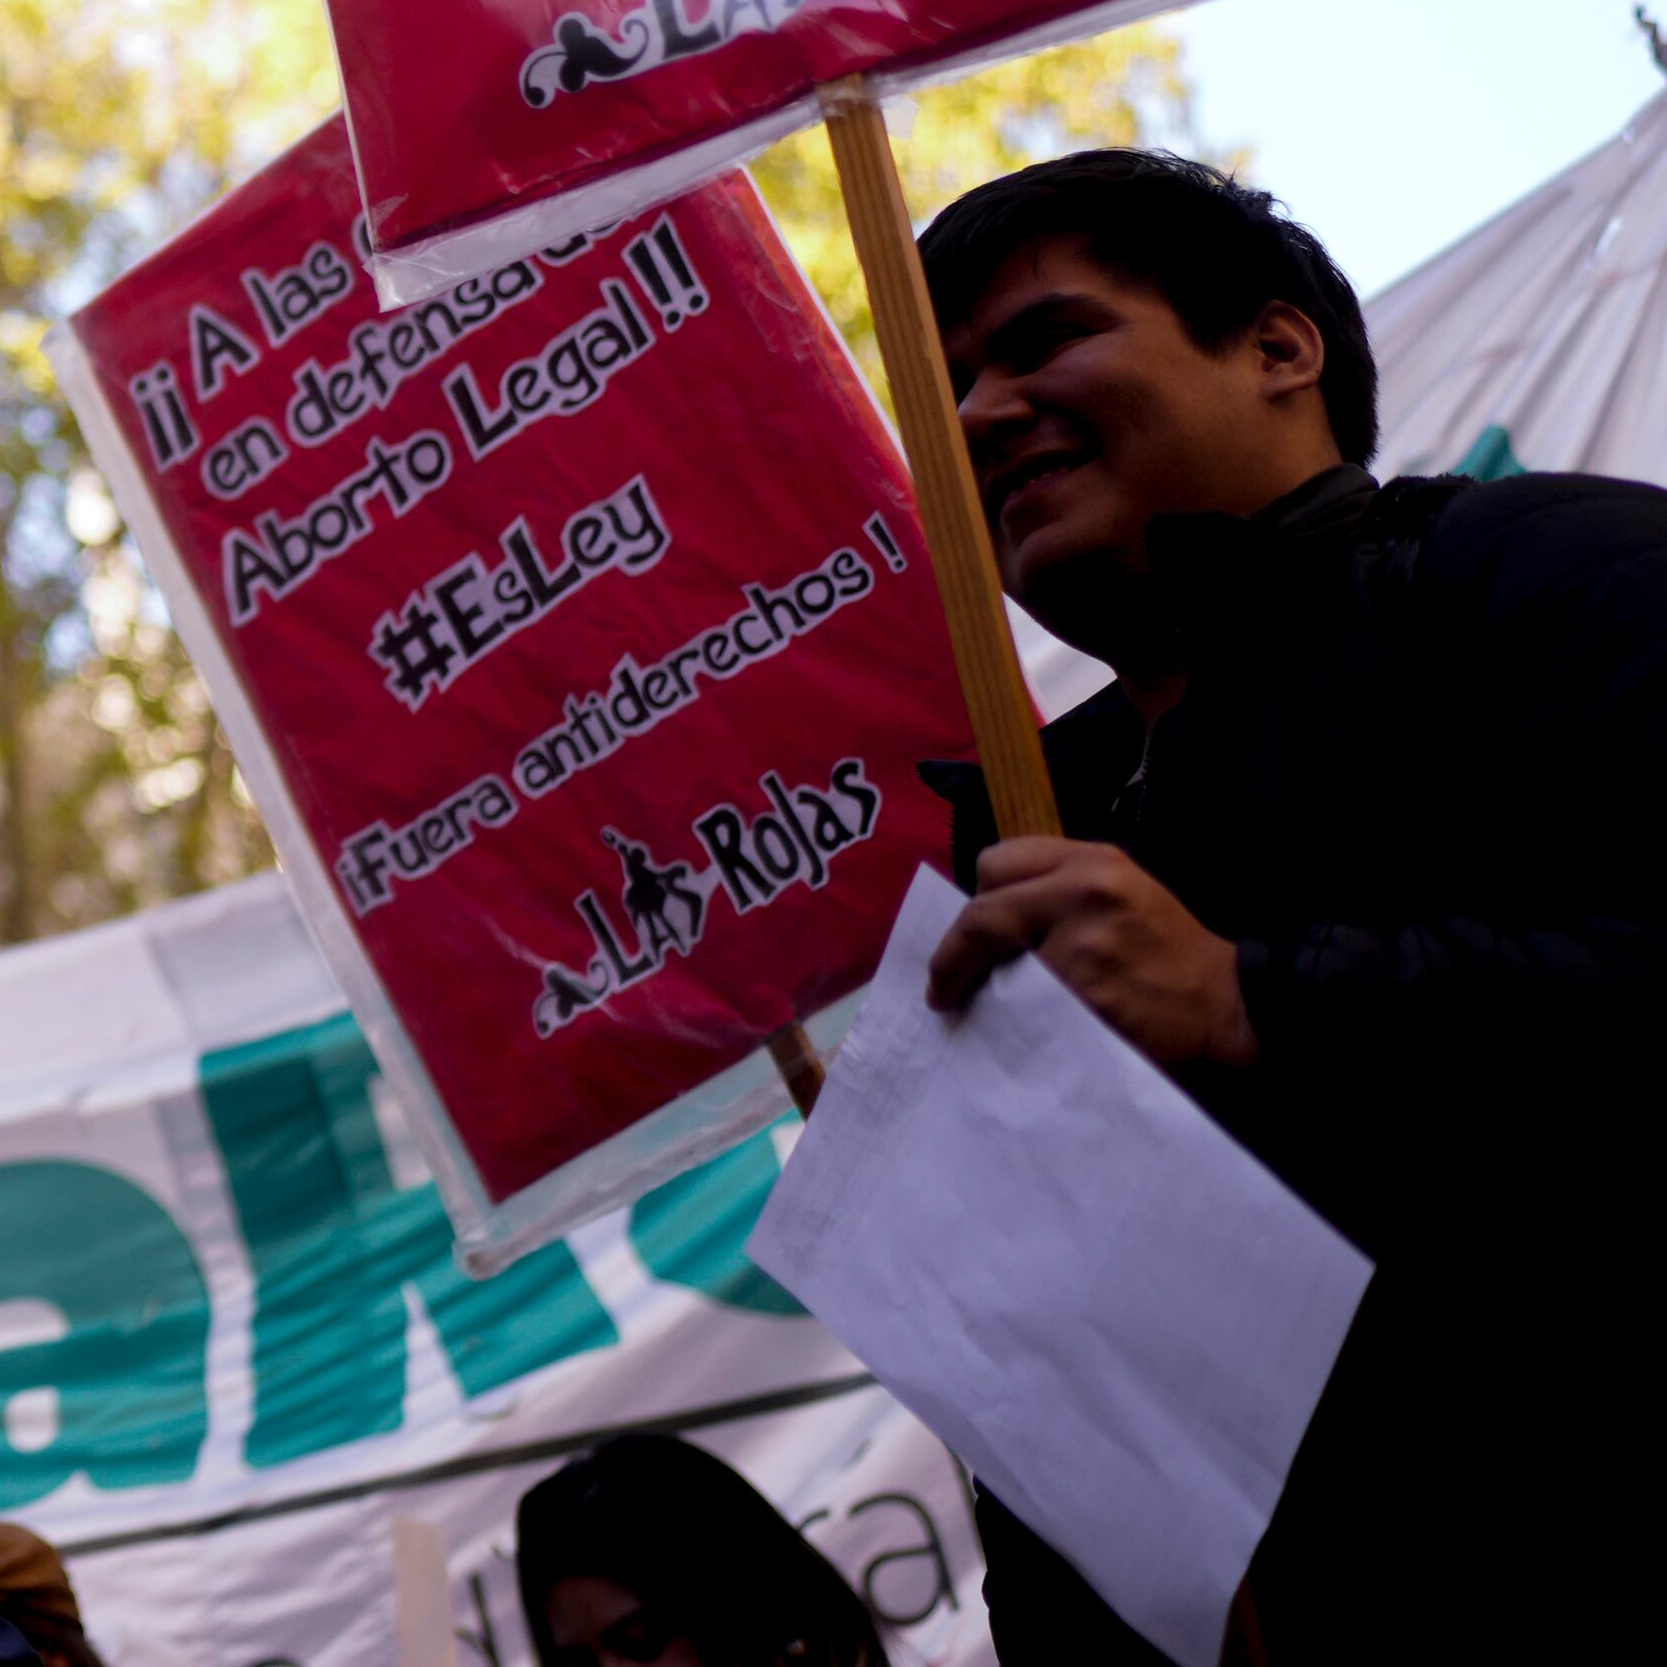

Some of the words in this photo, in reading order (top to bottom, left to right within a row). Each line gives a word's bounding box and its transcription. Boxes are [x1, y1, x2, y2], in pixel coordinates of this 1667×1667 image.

[203, 418, 287, 500] en
[286, 258, 545, 447] defensa
[244, 241, 353, 348] las
[222, 430, 451, 627] Aborto
[369, 477, 669, 711] #EsLey
